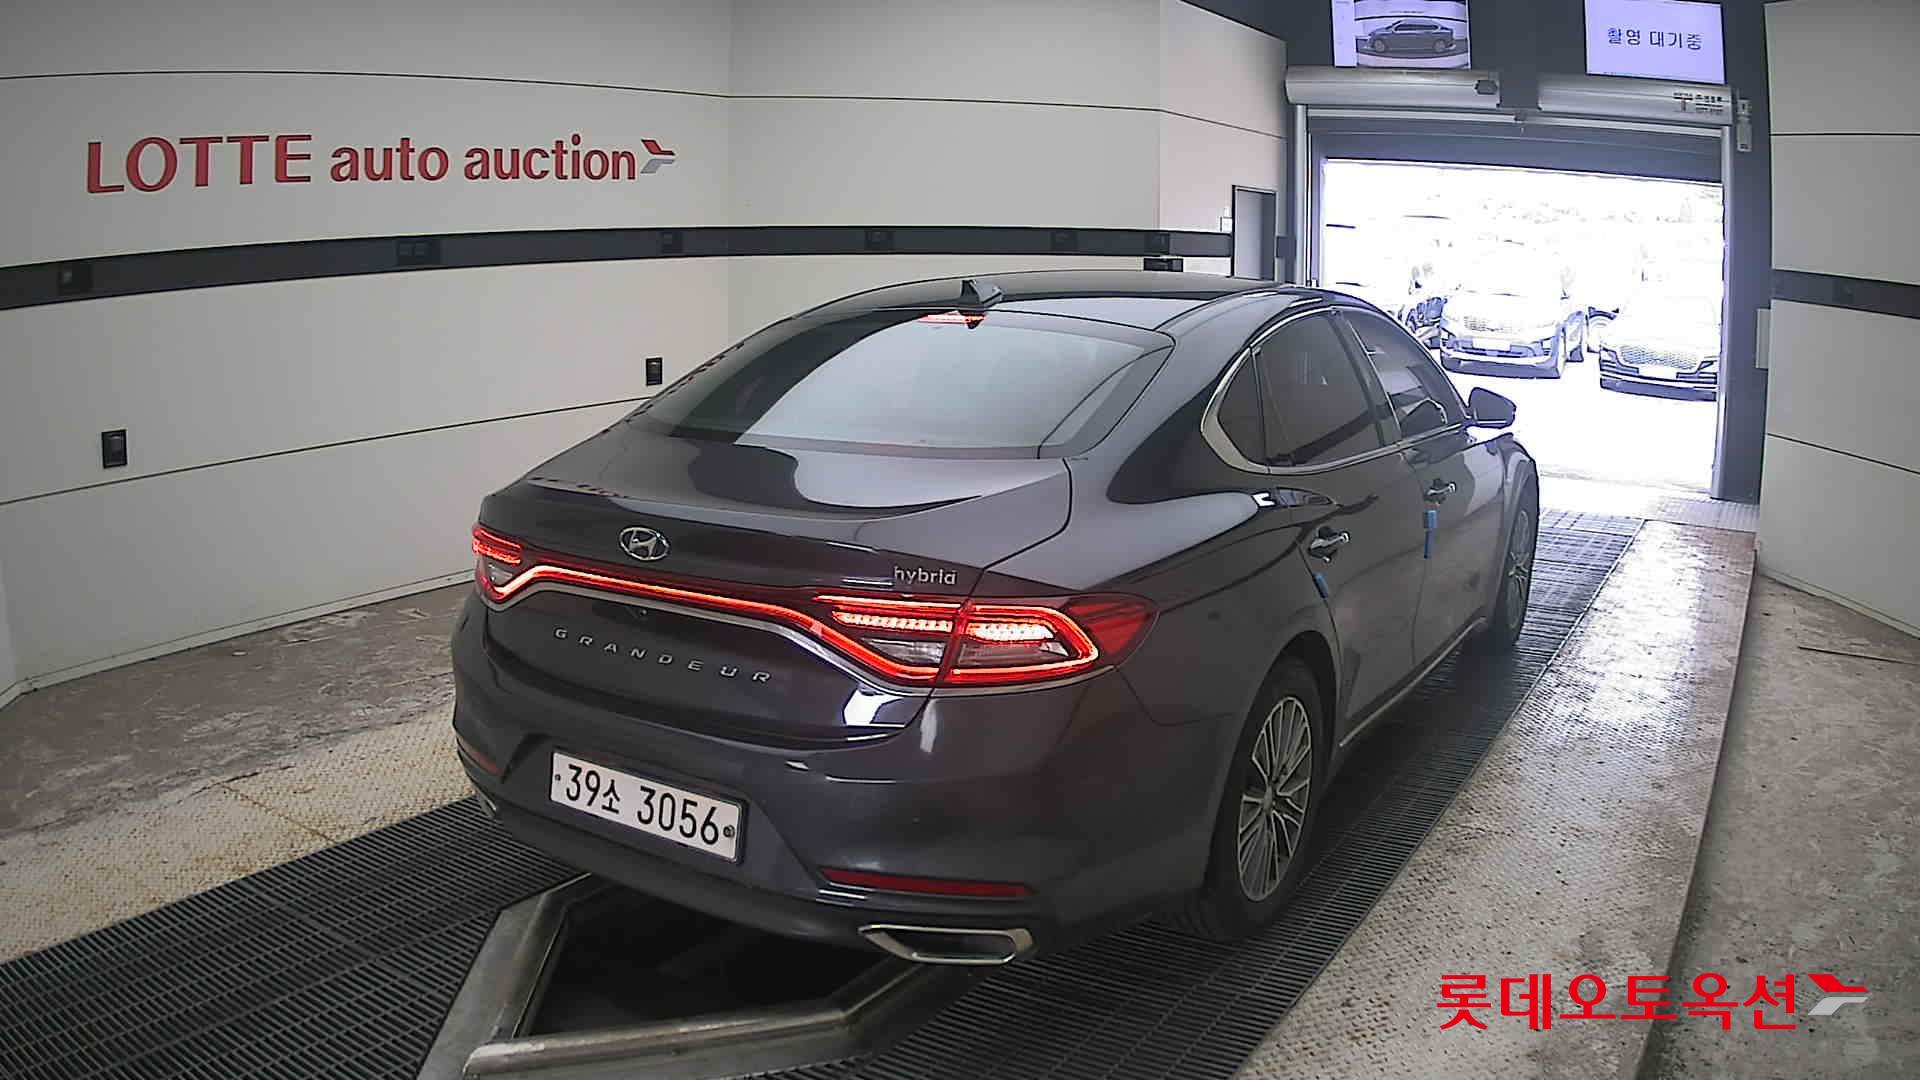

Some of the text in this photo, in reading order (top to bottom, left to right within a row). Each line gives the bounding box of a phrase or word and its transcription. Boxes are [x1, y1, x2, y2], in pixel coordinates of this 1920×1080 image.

[88, 133, 637, 194] LOTTE auto auction
[893, 565, 957, 586] hybrid
[554, 627, 771, 684] GRANDEUR
[565, 763, 720, 846] 39소 3056
